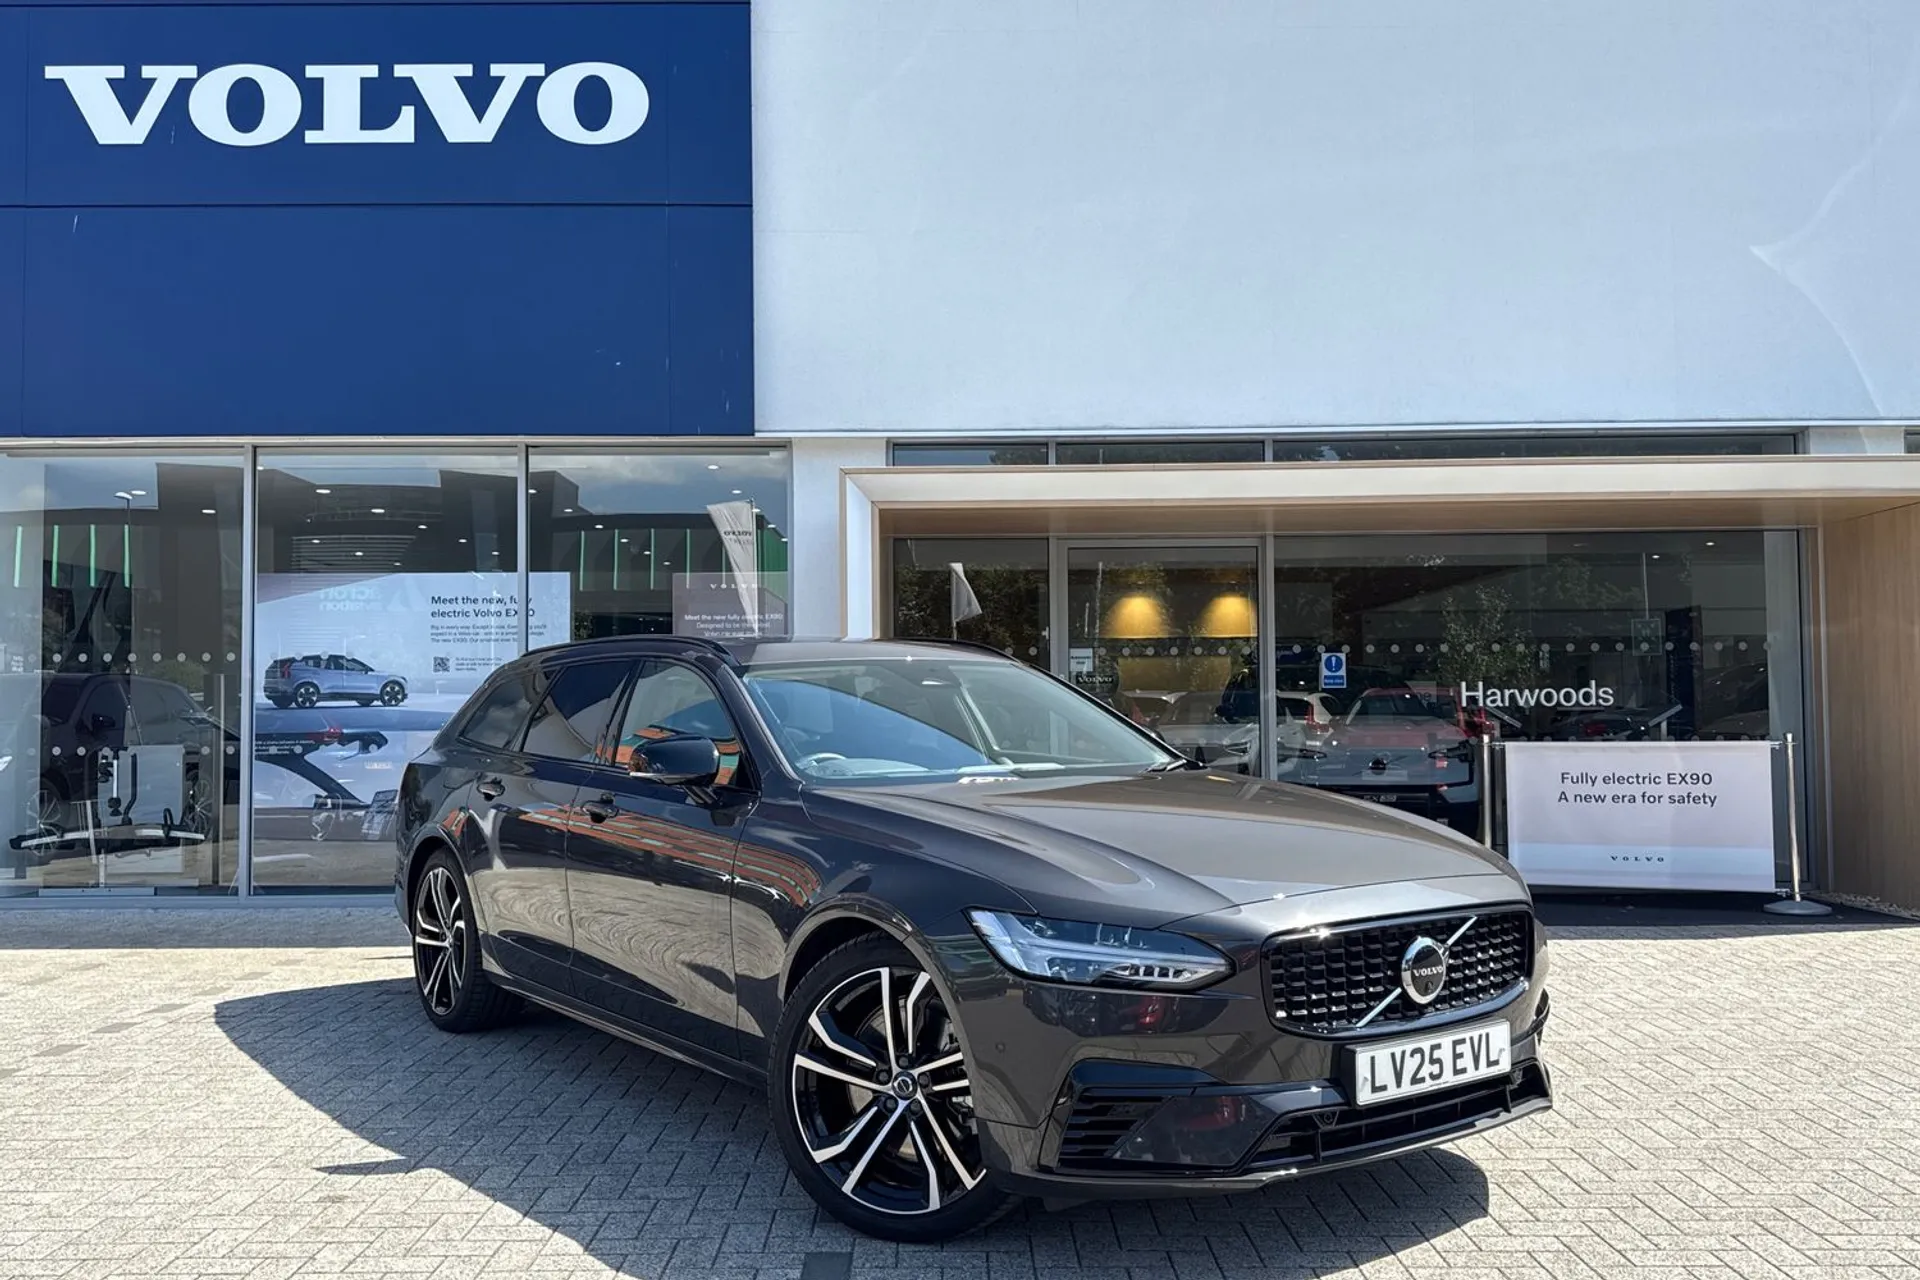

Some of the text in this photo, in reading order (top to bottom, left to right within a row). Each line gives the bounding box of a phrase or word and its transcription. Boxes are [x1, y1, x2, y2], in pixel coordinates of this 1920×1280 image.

[45, 62, 650, 146] VOLVO
[431, 595, 459, 605] Meet
[461, 595, 479, 605] the
[481, 597, 507, 606] new,
[430, 608, 535, 618] electric Volvo EX0
[1460, 679, 1615, 708] Harwoods
[1560, 772, 1713, 787] Fully electric EX90
[1558, 791, 1718, 807] A new era for safety
[1412, 965, 1444, 977] VOLVO
[1369, 1032, 1500, 1094] LV25 EVL
